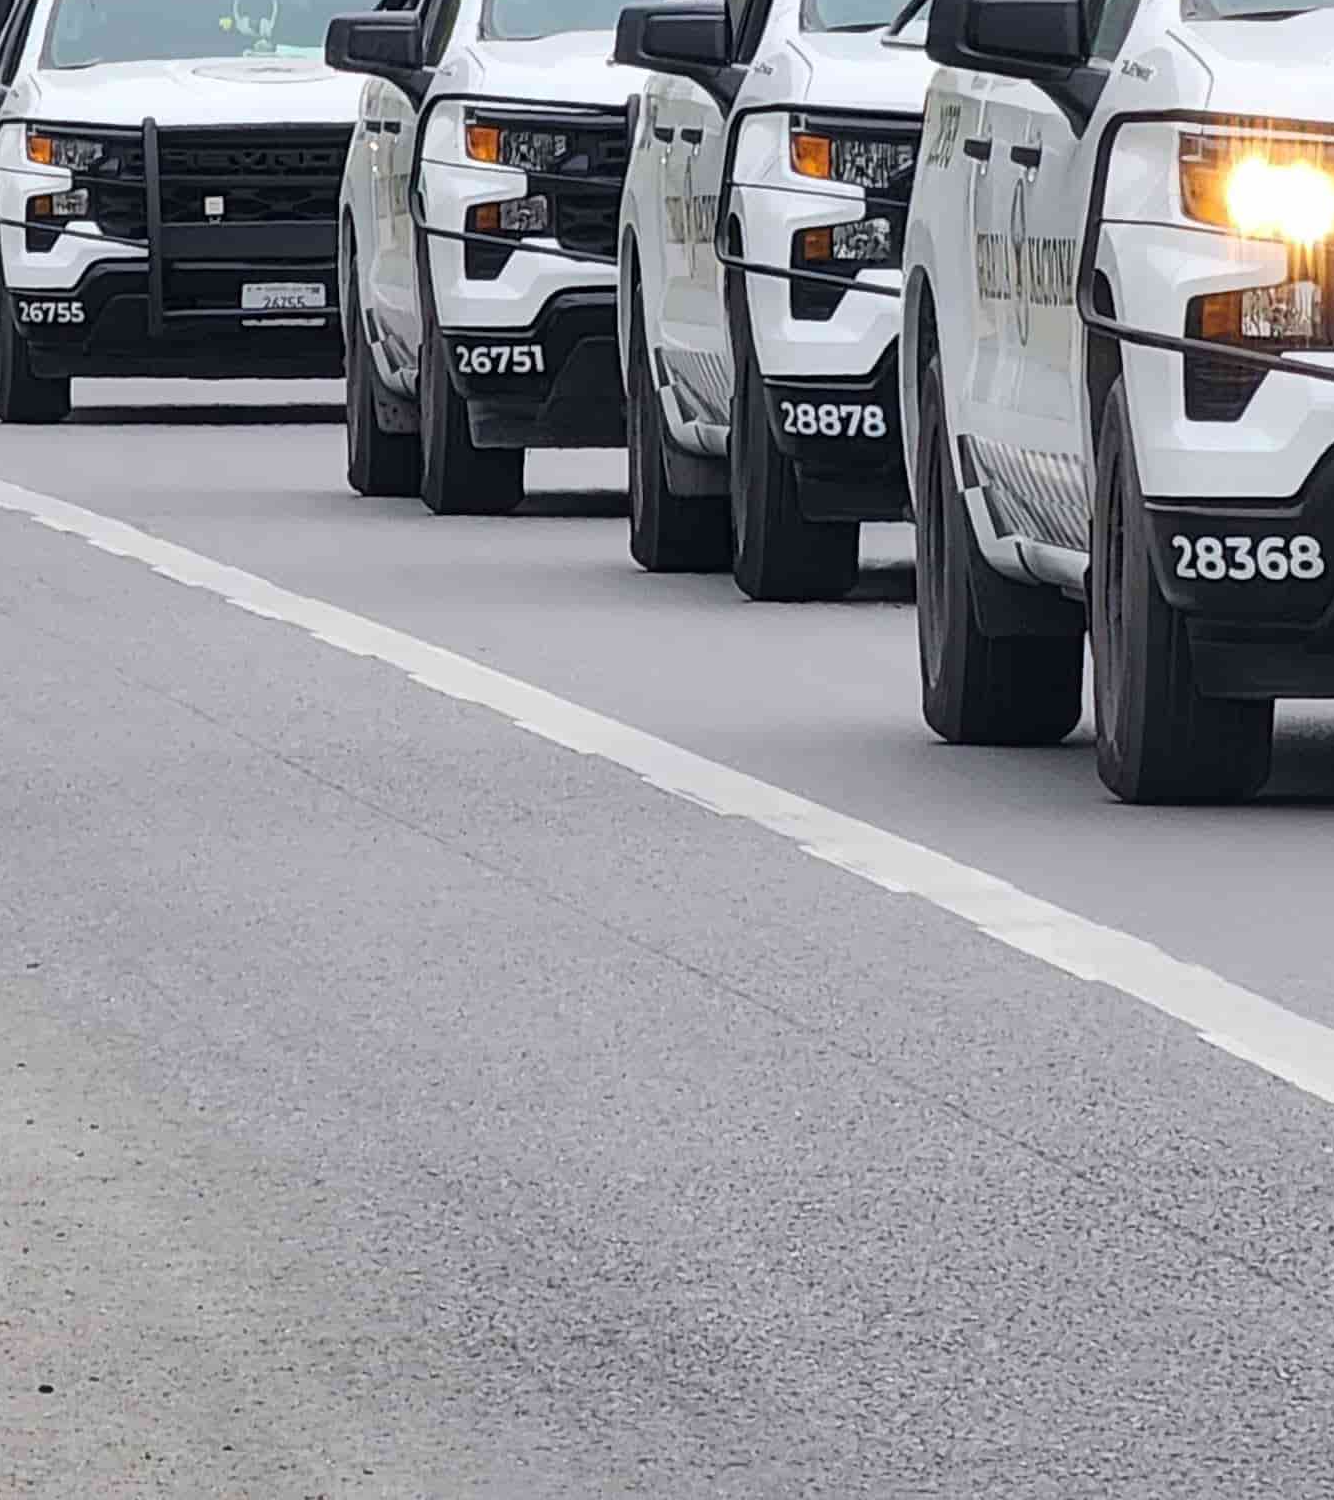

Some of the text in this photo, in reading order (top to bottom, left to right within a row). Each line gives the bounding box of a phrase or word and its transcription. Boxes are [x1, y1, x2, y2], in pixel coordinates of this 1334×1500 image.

[18, 300, 86, 324] 26755
[455, 344, 546, 375] 26751
[780, 401, 888, 438] 28878
[1171, 534, 1326, 581] 28368
